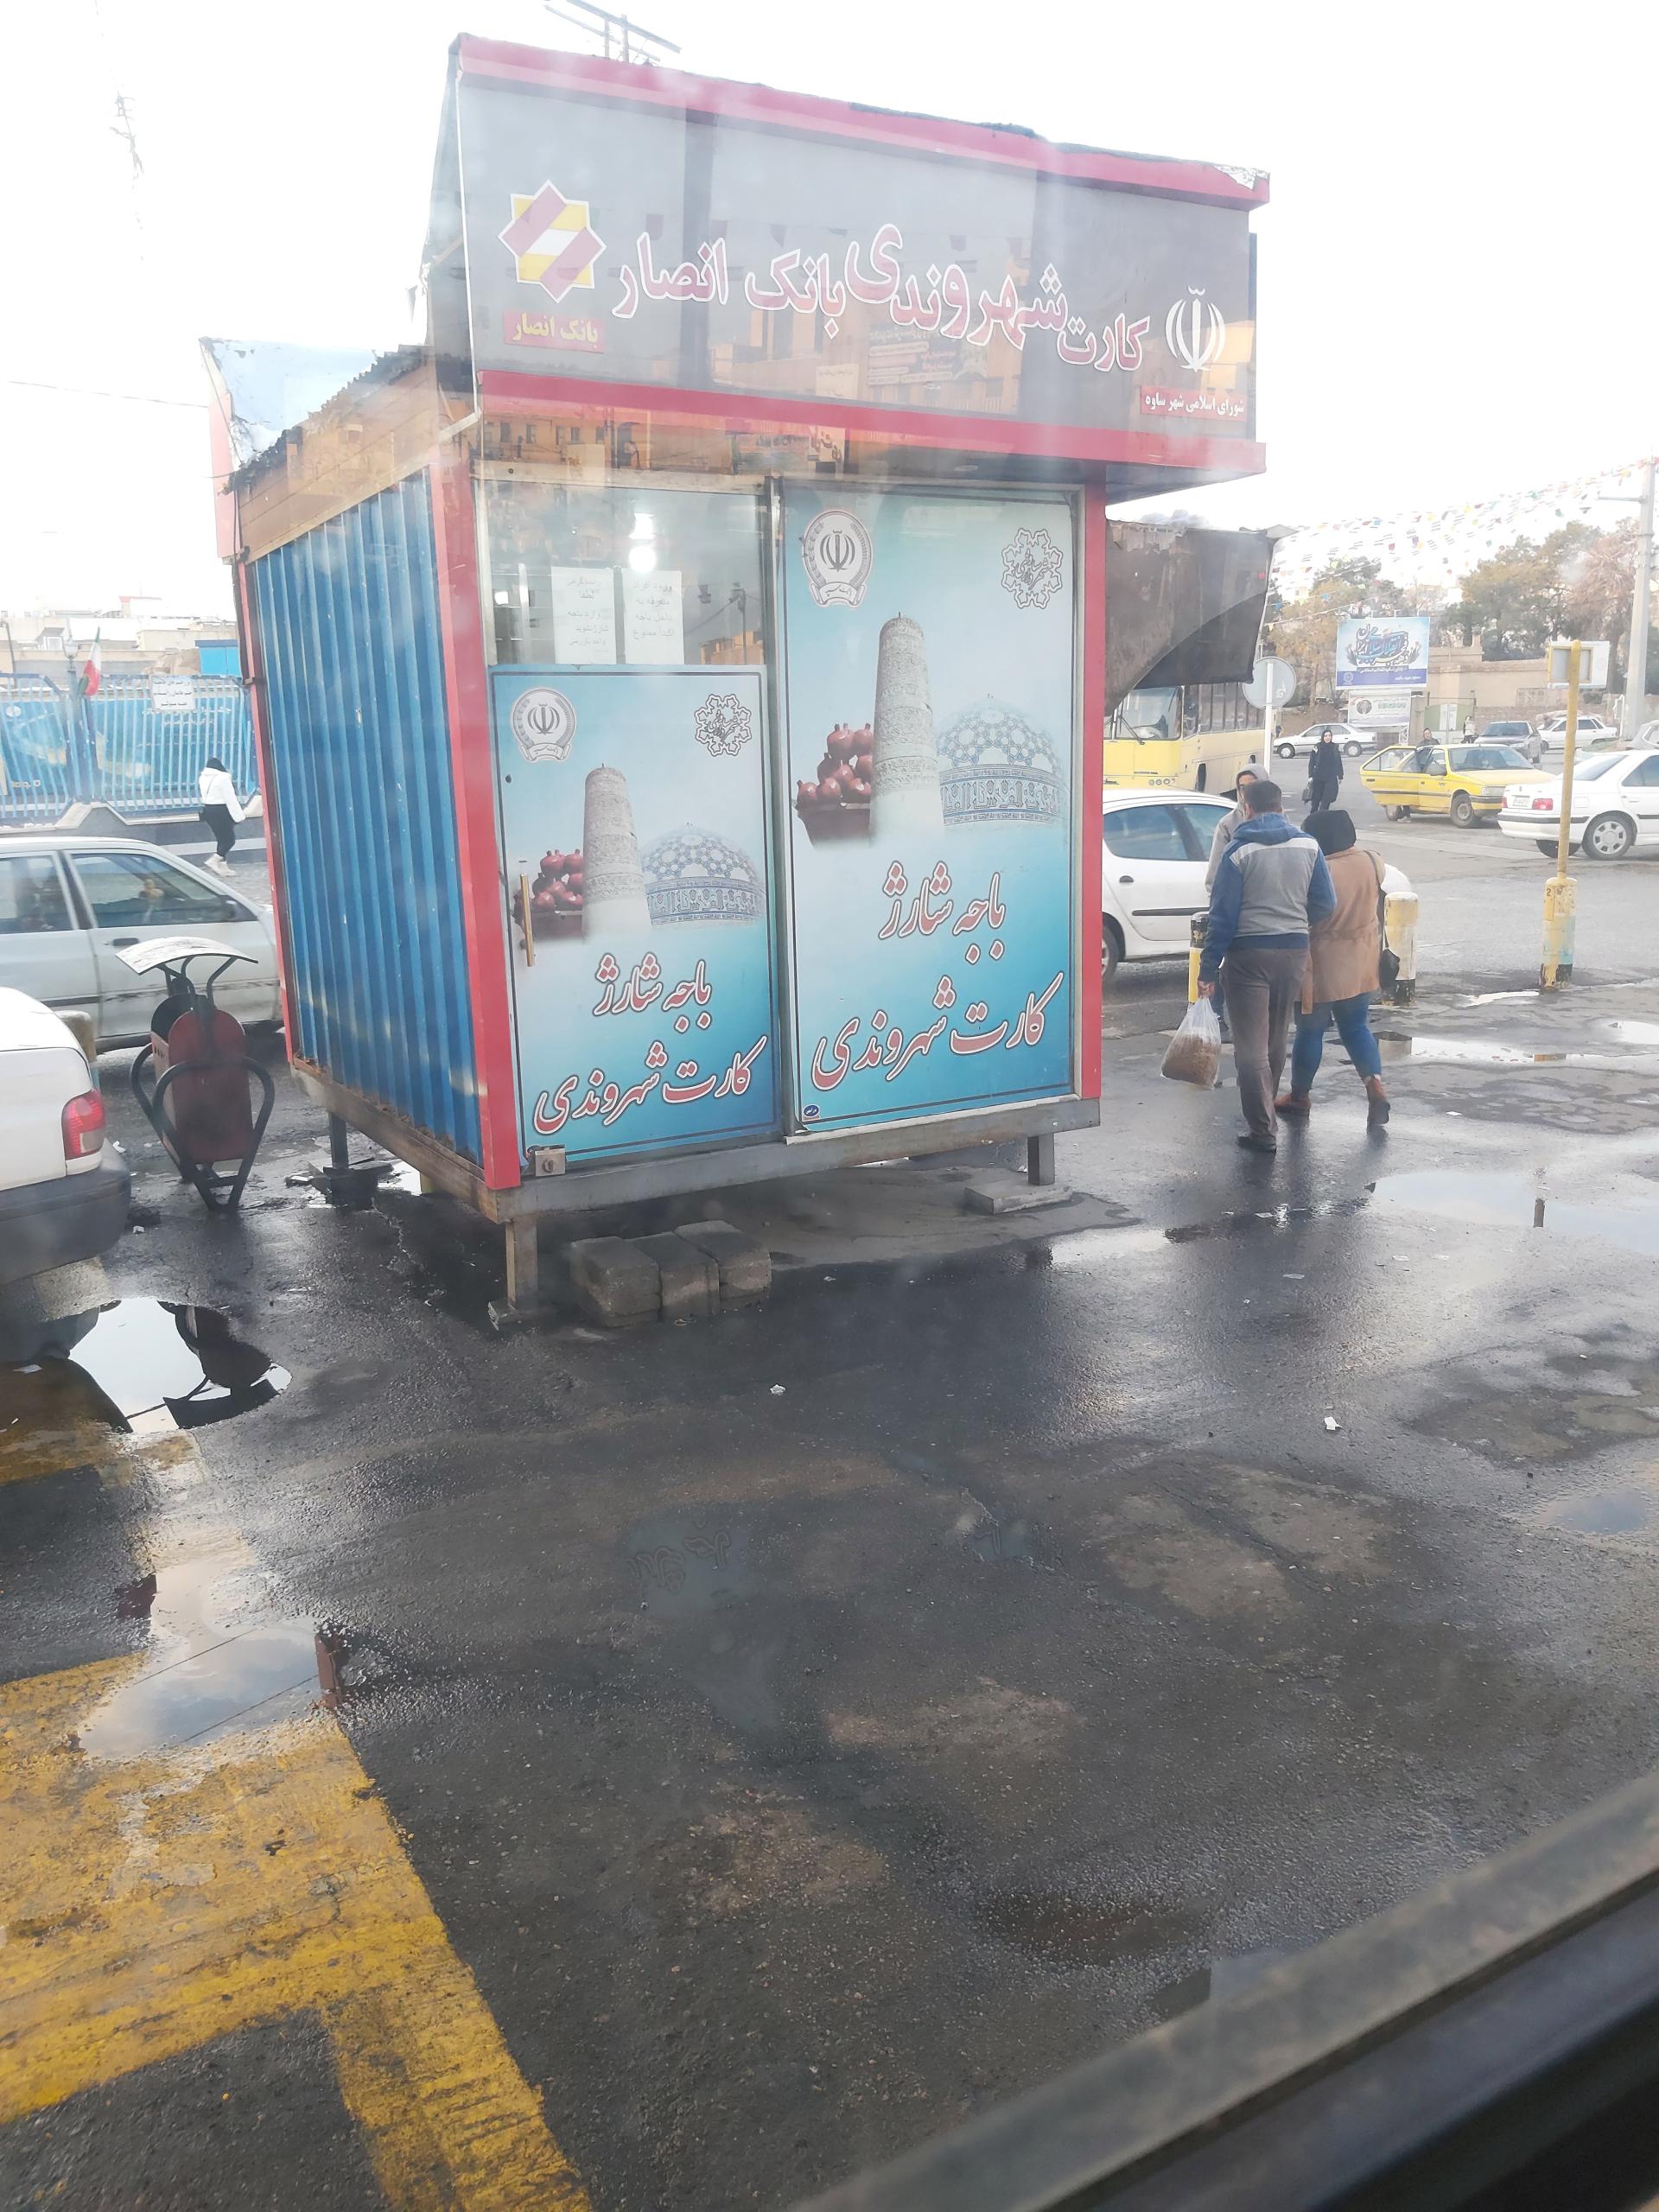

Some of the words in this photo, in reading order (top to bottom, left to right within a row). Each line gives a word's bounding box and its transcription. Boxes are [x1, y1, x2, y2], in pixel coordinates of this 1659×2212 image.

[611, 231, 730, 320] انصار
[744, 248, 847, 340] بانک
[844, 223, 1068, 351] شهروندی
[511, 312, 556, 341] انصار
[560, 318, 599, 349] بانک
[1056, 312, 1151, 372] کارت
[1145, 391, 1166, 410] ساوه
[1167, 394, 1185, 412] شهر
[1185, 394, 1216, 413] اسلامی
[1217, 399, 1245, 417] شورای
[879, 861, 953, 939] شارژ
[952, 872, 1007, 964] باجه
[592, 952, 664, 1016] شارژ
[662, 959, 713, 1033] باجه
[950, 970, 1065, 1055] کارت
[811, 975, 957, 1091] شهروندی
[533, 1039, 669, 1135] شهروندی
[662, 1035, 768, 1104] کارت
